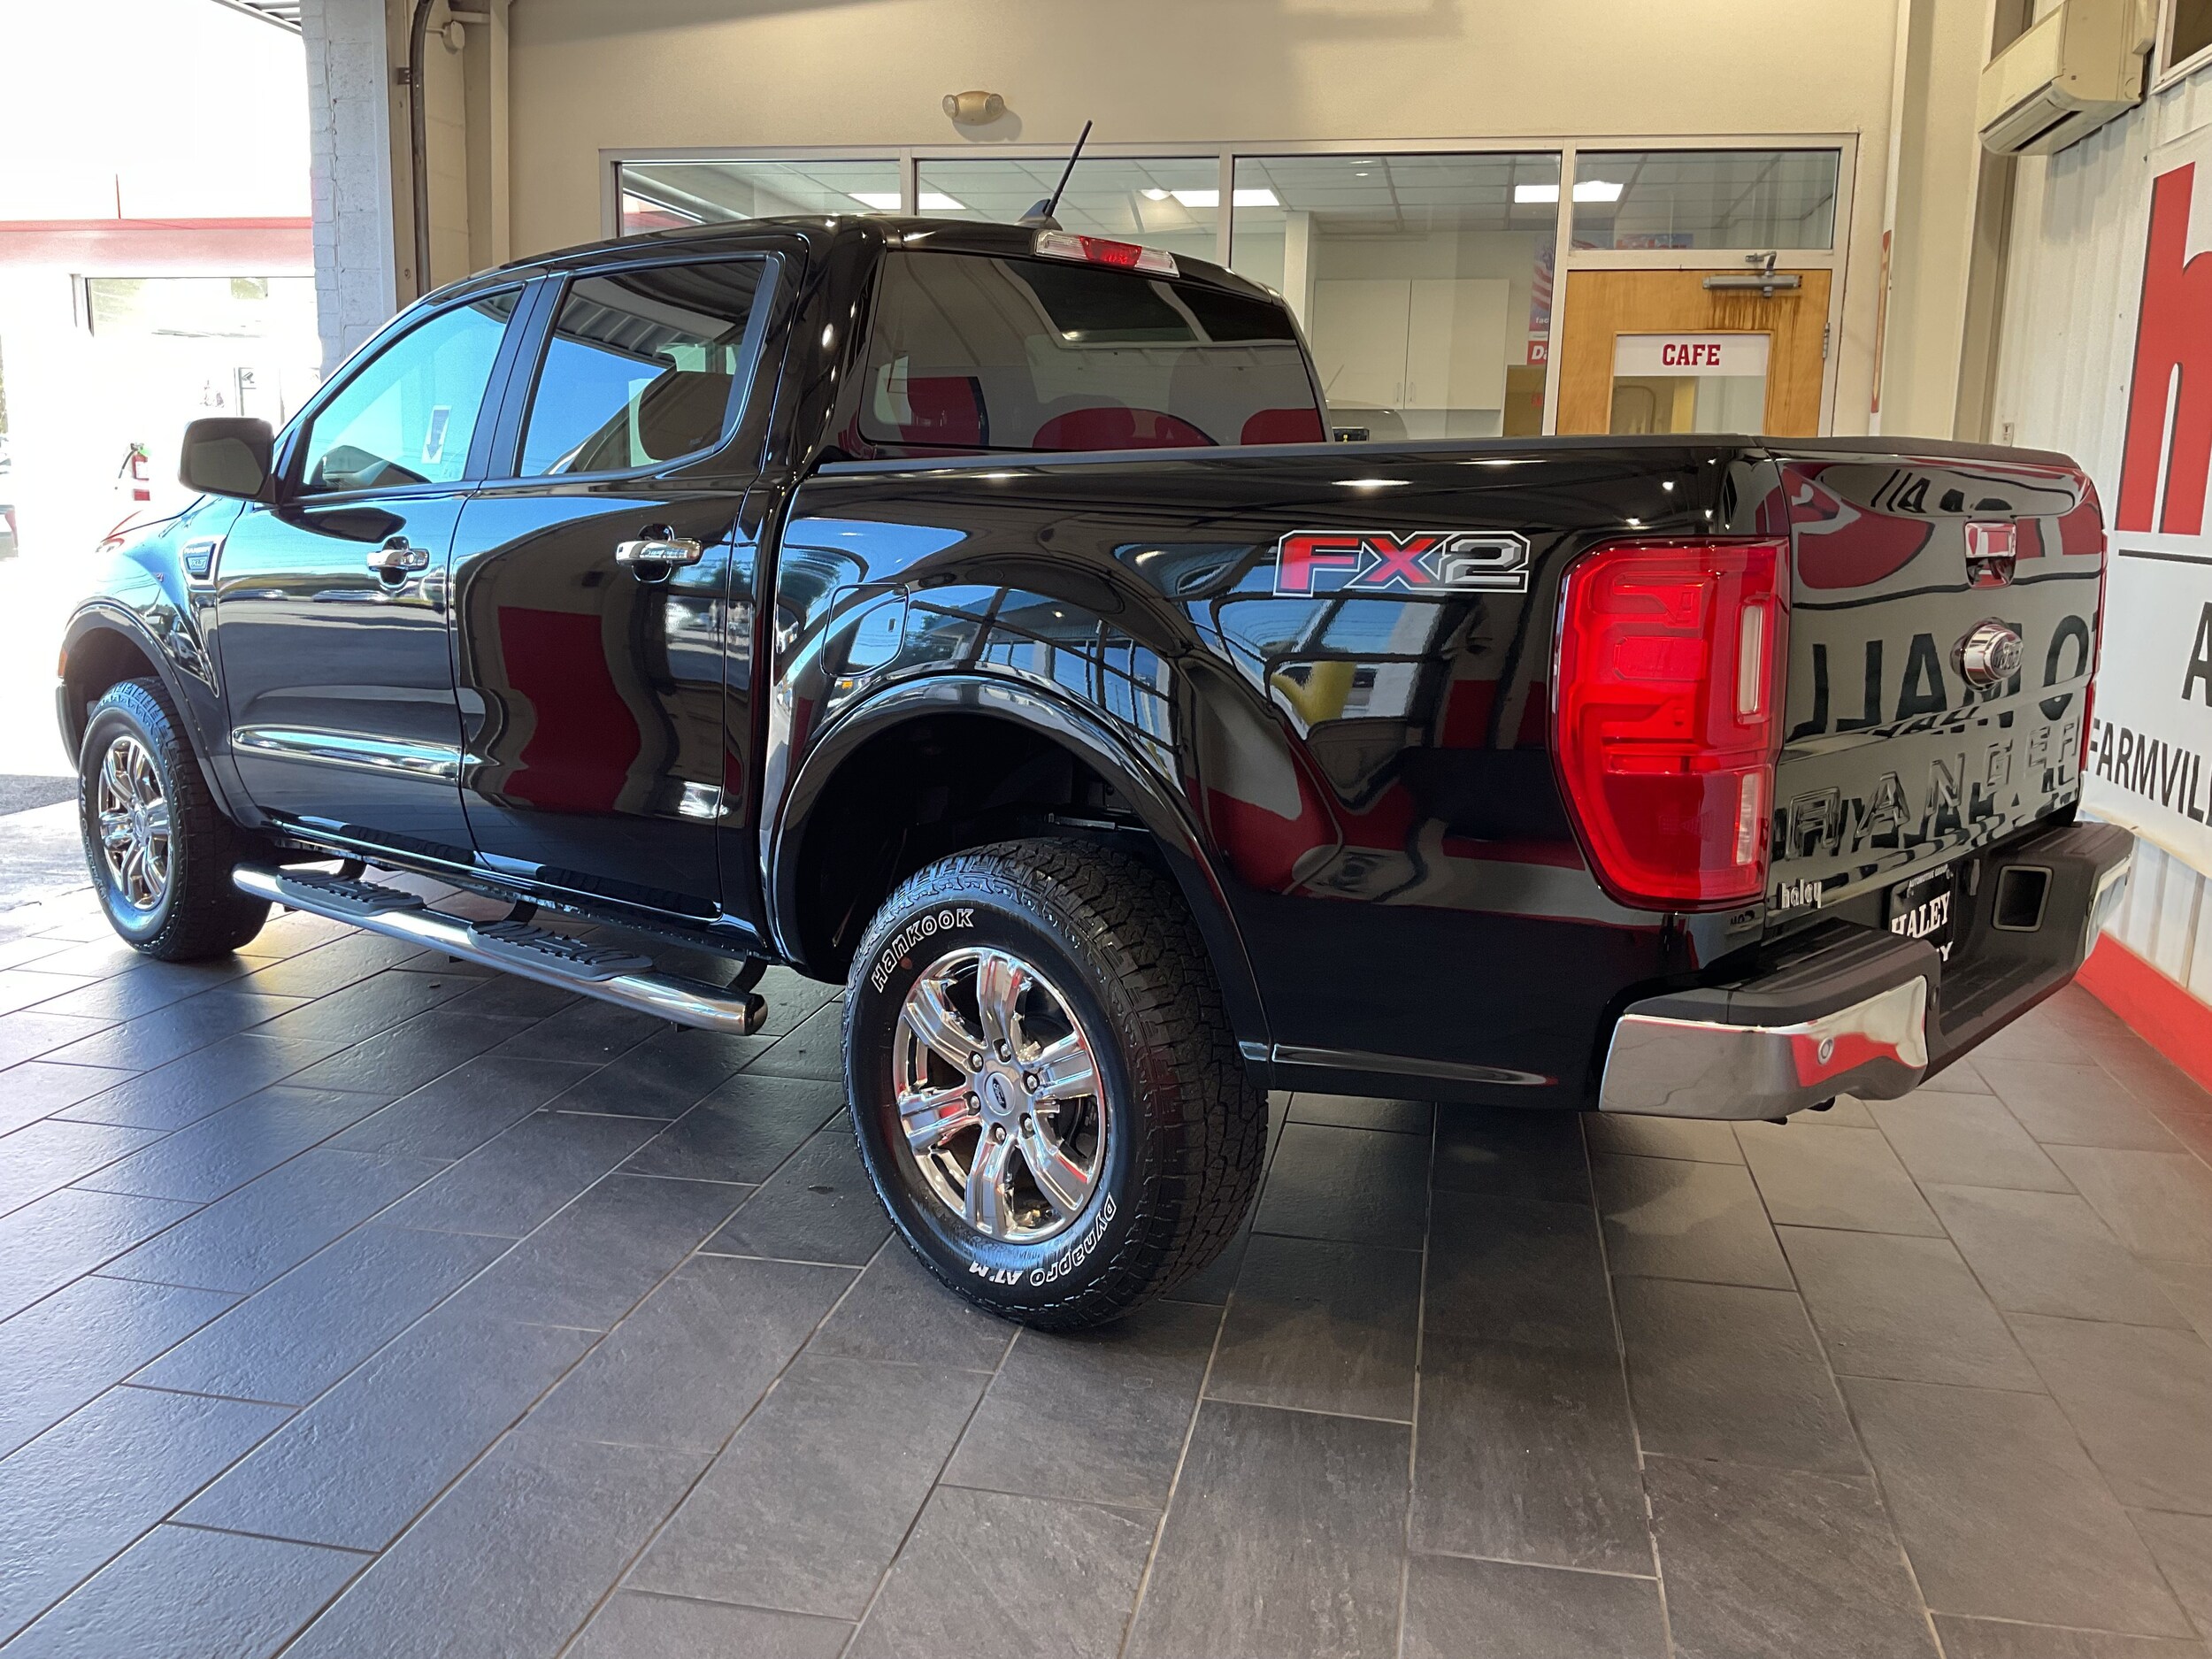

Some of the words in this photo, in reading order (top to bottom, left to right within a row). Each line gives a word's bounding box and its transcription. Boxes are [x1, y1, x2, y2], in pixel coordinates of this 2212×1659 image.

[1662, 343, 1721, 366] CAFE
[1273, 531, 1530, 597] FX2
[1780, 878, 1822, 910] haley
[1892, 890, 1951, 938] HALEY
